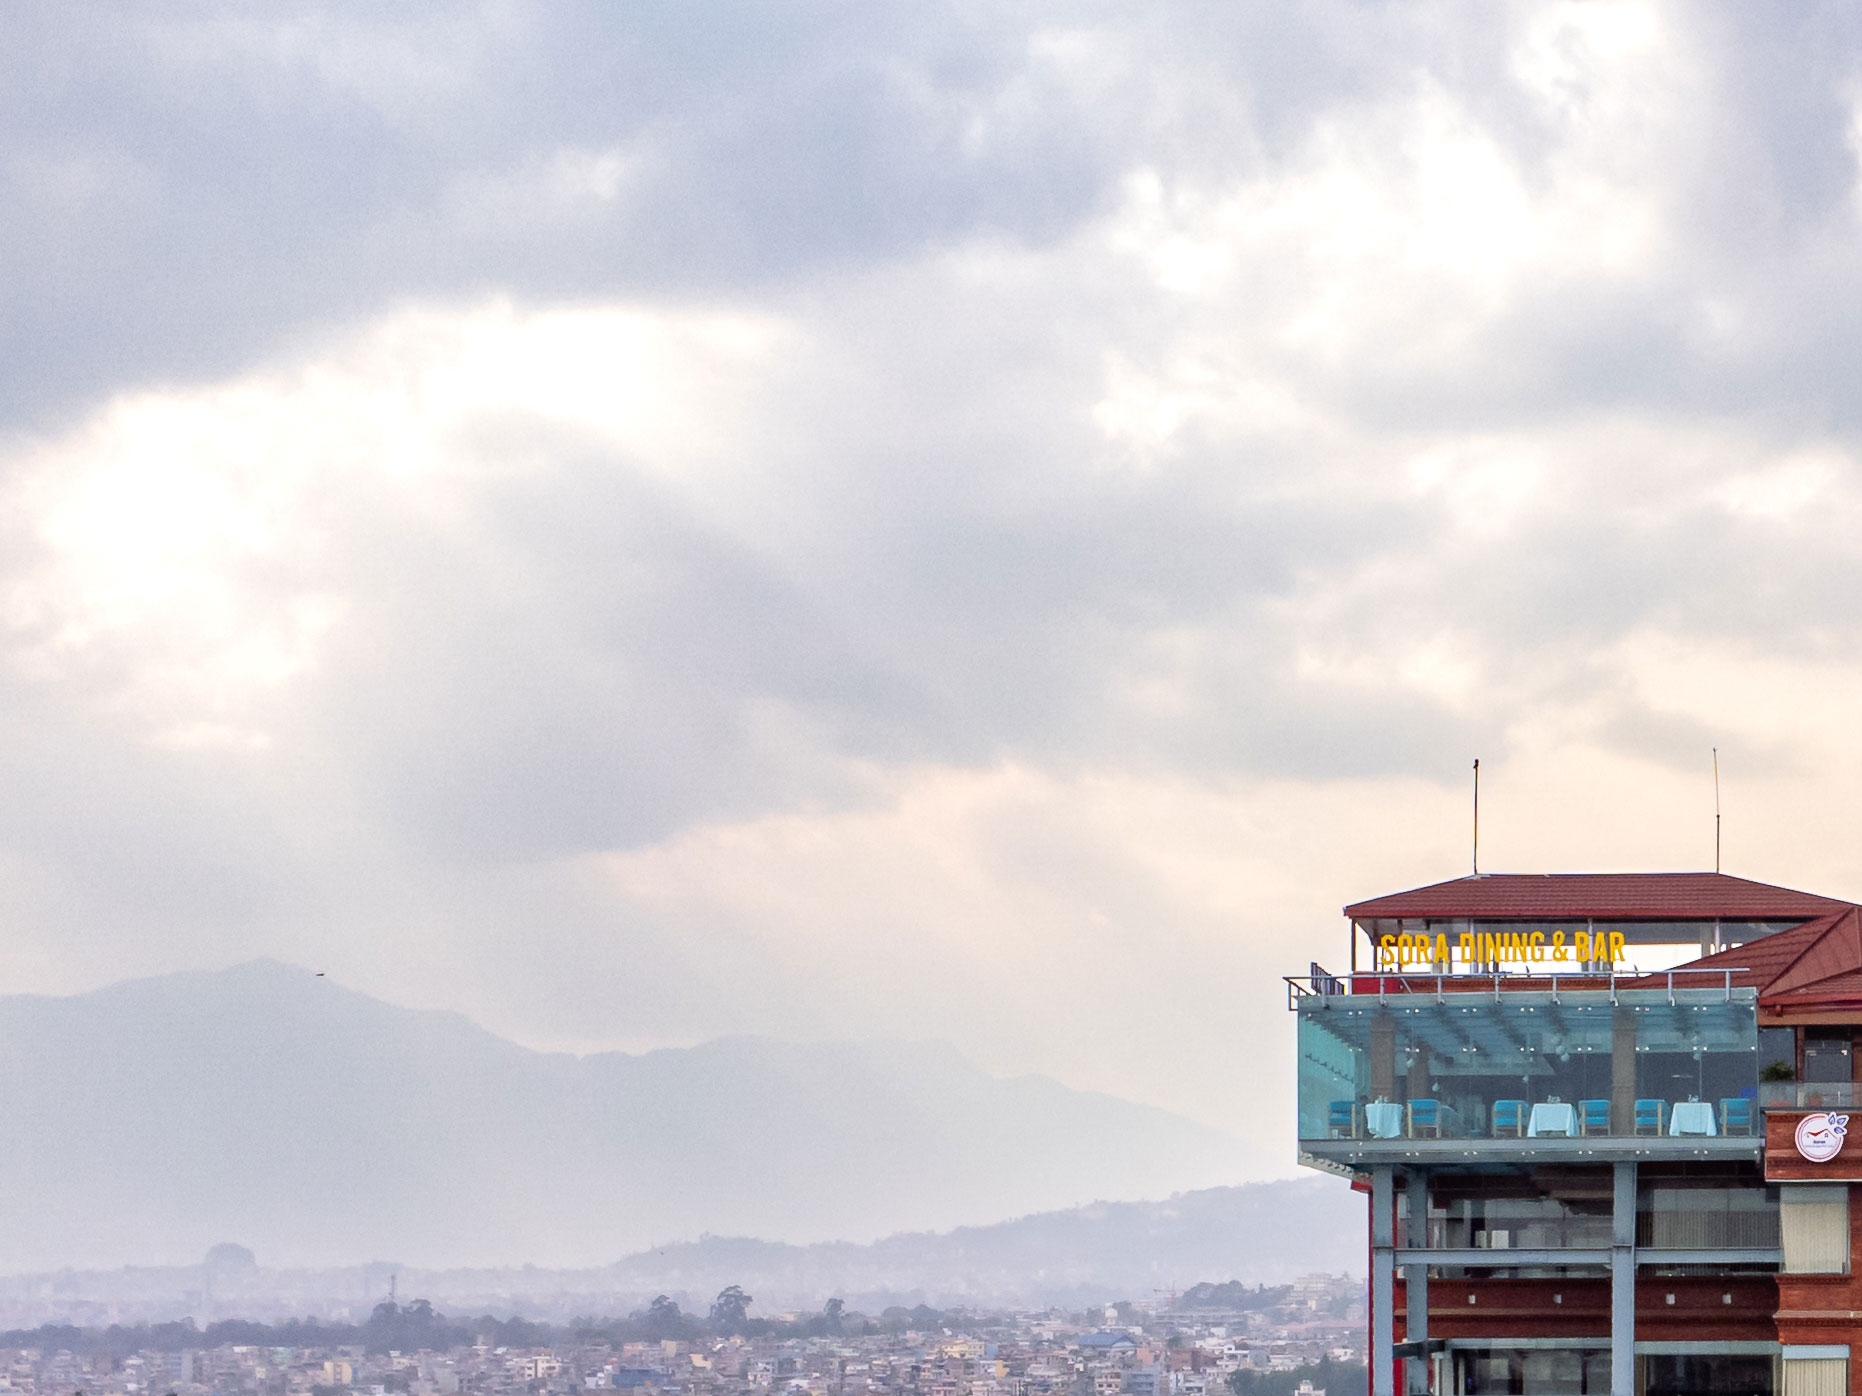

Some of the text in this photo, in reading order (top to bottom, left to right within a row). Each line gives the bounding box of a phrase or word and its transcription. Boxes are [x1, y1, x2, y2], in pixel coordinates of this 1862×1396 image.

[1380, 930, 1626, 965] SORA DINING & BAR
